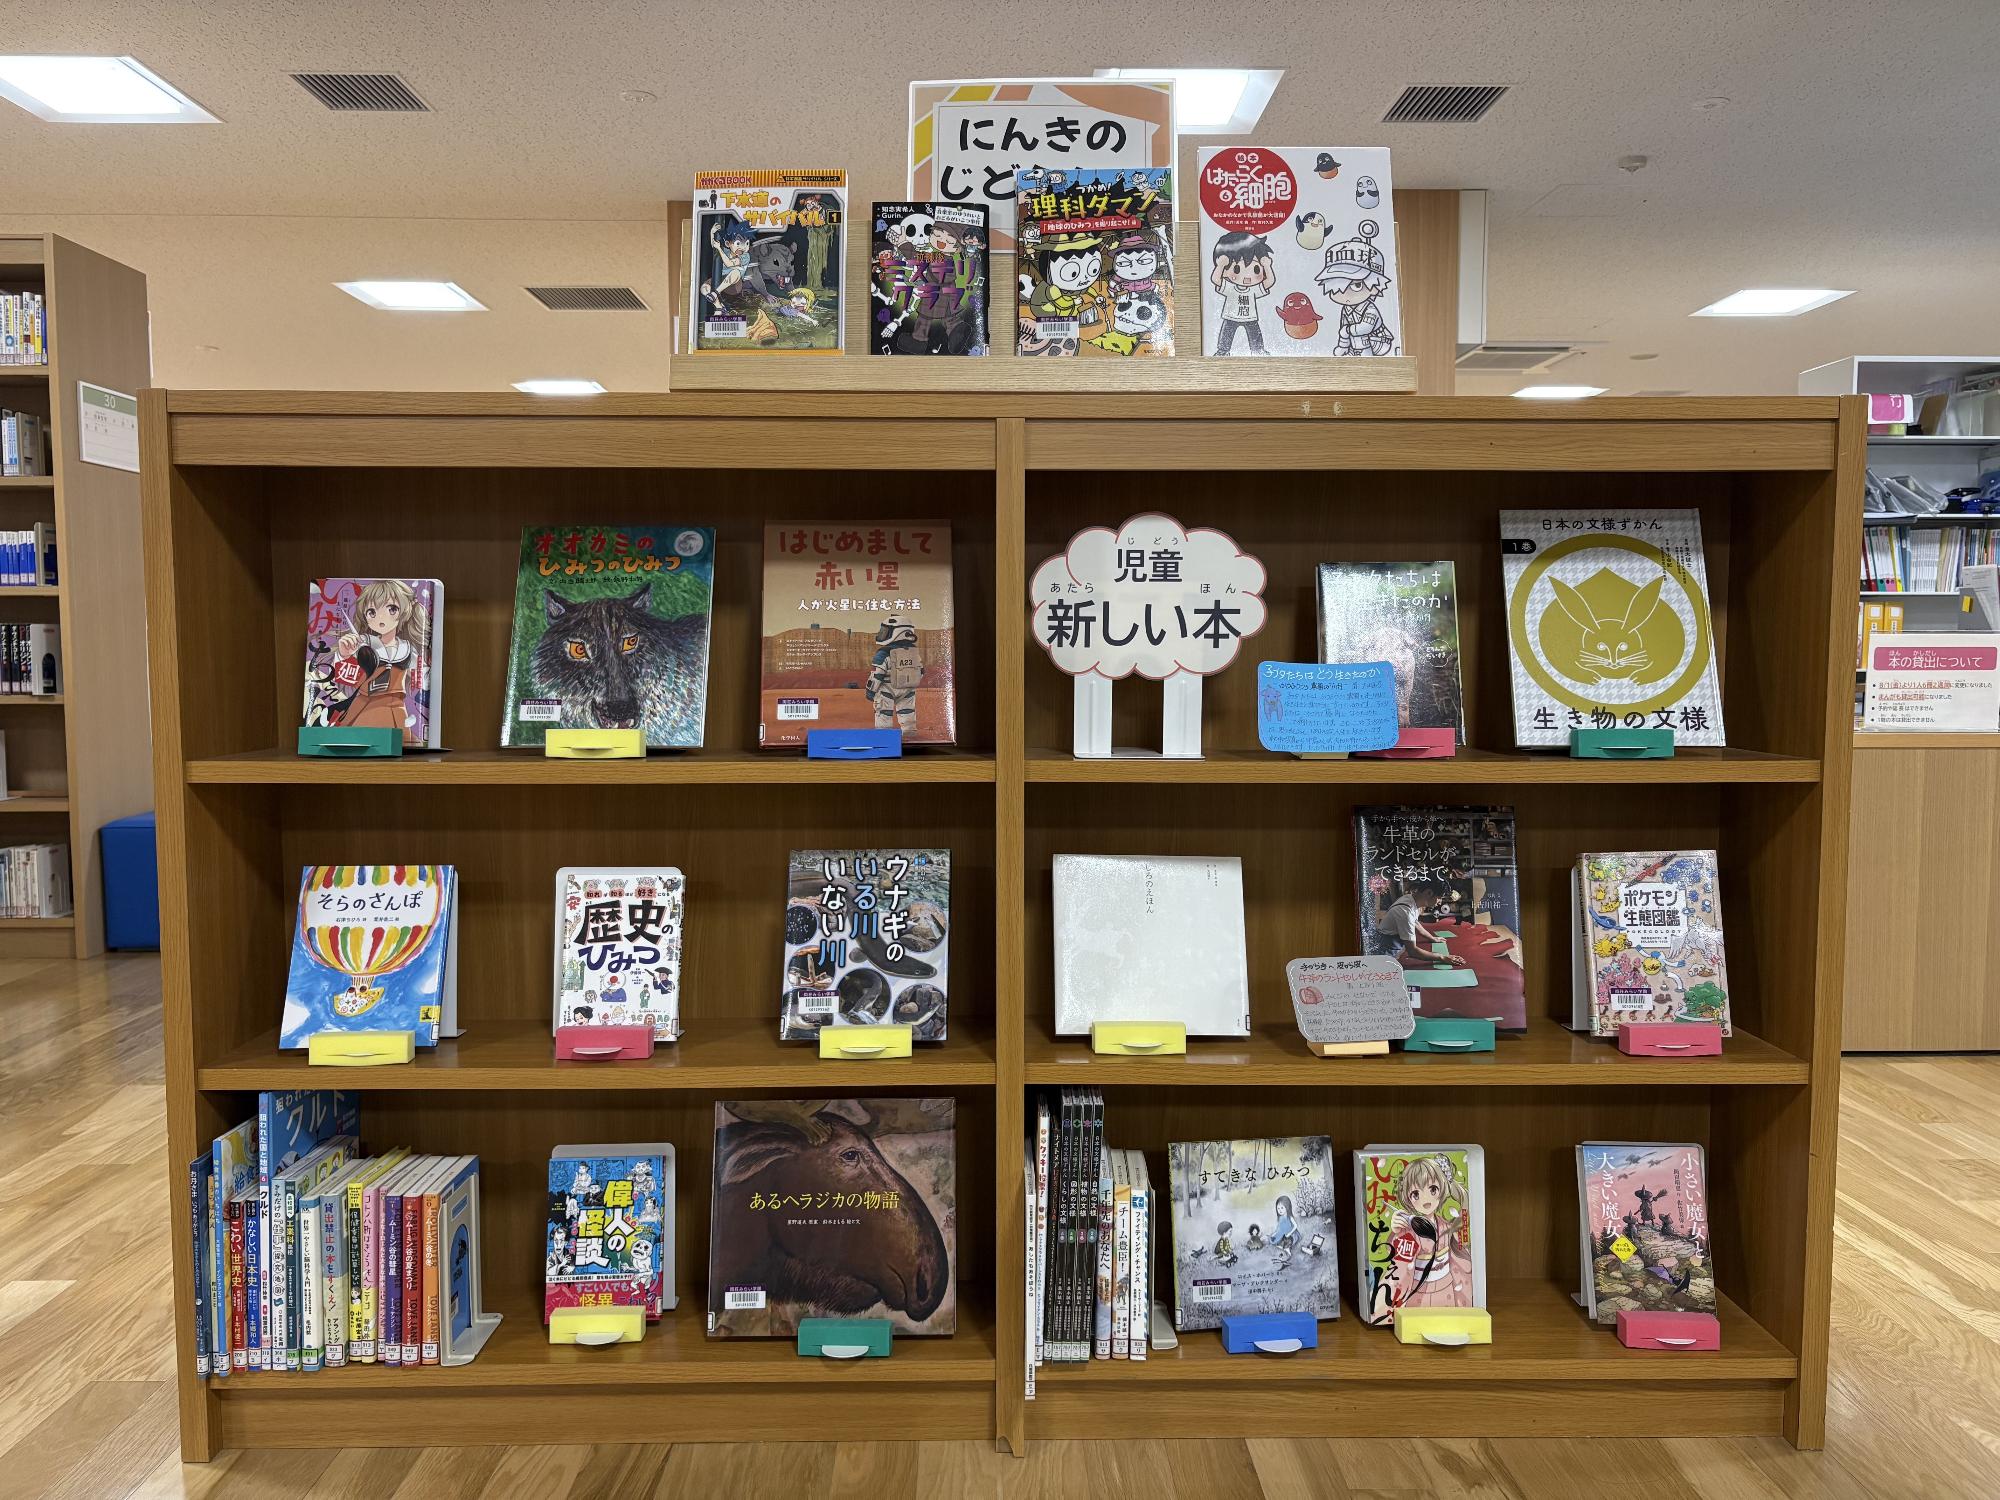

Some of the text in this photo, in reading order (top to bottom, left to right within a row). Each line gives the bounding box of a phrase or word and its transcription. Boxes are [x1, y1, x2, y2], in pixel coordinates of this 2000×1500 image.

[959, 115, 1127, 153] にんきの
[1206, 165, 1263, 188] はたらく
[720, 190, 781, 208] 下水道の
[1230, 172, 1291, 209] 細胞
[743, 209, 826, 227] サバイバル
[832, 213, 837, 222] 1
[1032, 191, 1158, 220] 理科ダマン
[884, 259, 977, 284] ミステリ
[1237, 294, 1250, 318] 細胞
[104, 394, 116, 408] 30
[1542, 518, 1663, 531] 日本の文様ずかん
[536, 532, 654, 555] オオカミの
[779, 529, 933, 554] はじめまして
[538, 555, 681, 577] ひみつのひみつ
[814, 561, 900, 591] 赤い星
[1114, 548, 1184, 583] 児童
[1050, 582, 1094, 593] あたら
[798, 598, 921, 611] 人が火星に住む方法
[1046, 598, 1242, 648] 新しい本
[1888, 656, 1983, 668] 本の貸出について
[1533, 706, 1710, 732] 生き物の文様
[1382, 825, 1435, 843] 牛革の
[1364, 845, 1457, 863] ランドセルが
[1374, 863, 1449, 882] できるまで
[850, 858, 879, 940] いる川
[883, 855, 909, 962] ウナギの
[1623, 890, 1678, 907] ポケモン
[573, 899, 673, 945] 歴史の
[818, 858, 847, 968] いない川
[1623, 910, 1681, 927] 生態図鑑
[577, 943, 661, 974] ひみつ
[1199, 1165, 1310, 1186] すてきな ひみつ
[259, 1191, 269, 1220] クルド
[749, 1191, 900, 1211] あるヘラジカの物語
[1597, 1152, 1622, 1239] 大きい魔女
[1680, 1153, 1706, 1260] 小さい魔女と
[575, 1208, 611, 1268] 怪談
[1100, 1188, 1113, 1270] 千年先のあなたへ
[230, 1221, 242, 1288] こわい世界史
[246, 1219, 258, 1288] かなしい日本史
